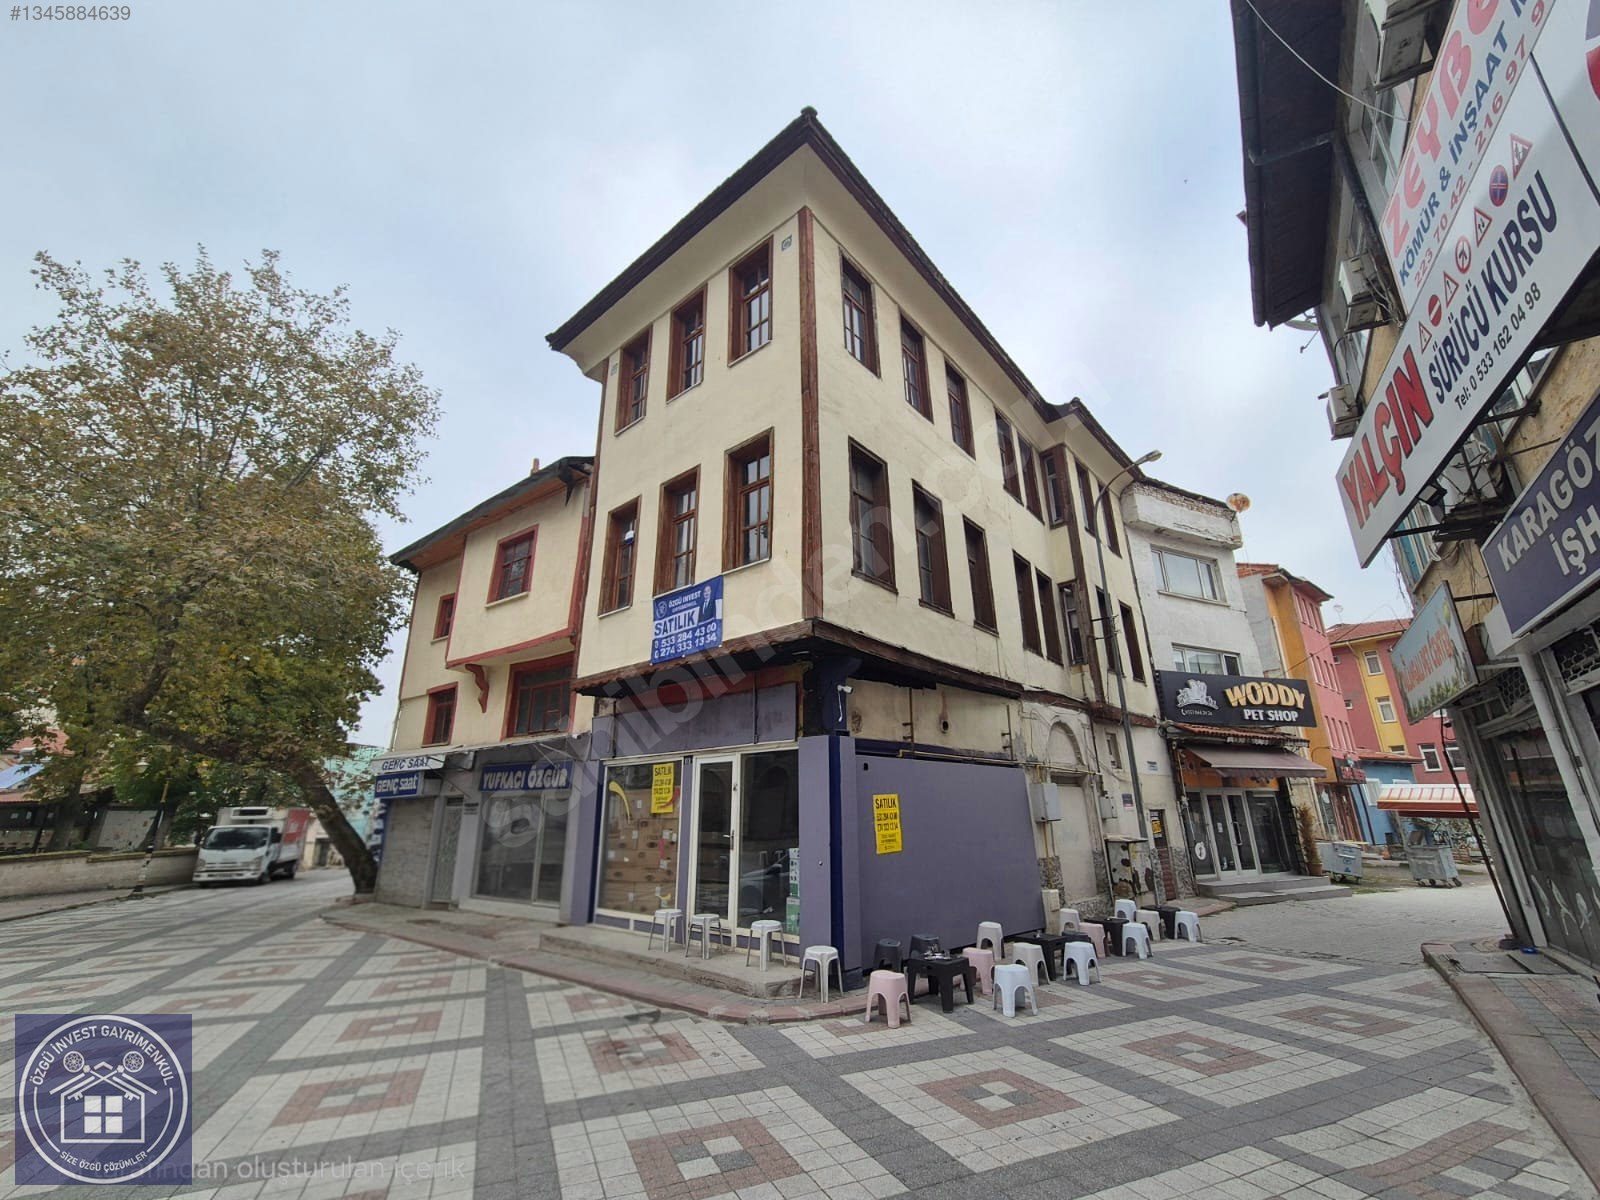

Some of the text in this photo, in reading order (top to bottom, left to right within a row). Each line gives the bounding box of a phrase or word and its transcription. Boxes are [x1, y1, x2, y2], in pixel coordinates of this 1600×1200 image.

[1399, 192, 1440, 287] KÖMÜR
[1449, 20, 1508, 165] İNŞAAT
[1414, 250, 1434, 288] 223
[1433, 213, 1448, 244] 70
[1450, 175, 1466, 210] 42
[1475, 94, 1503, 150] 216
[1429, 170, 1558, 405] SÜRÜCÜ KURSU
[1454, 387, 1472, 411] Tel:
[1476, 357, 1494, 383] 533
[1493, 326, 1513, 357] 162
[1510, 303, 1526, 331] 04
[1524, 281, 1541, 310] 98
[1342, 344, 1435, 530] YALÇIN
[654, 610, 696, 636] SATILIK
[660, 645, 675, 657] 274
[676, 640, 692, 652] 333
[694, 636, 705, 647] 13
[661, 635, 675, 647] 533
[694, 626, 706, 637] 43
[1224, 682, 1305, 709] WODDY
[1244, 709, 1299, 722] PET SHOP
[376, 779, 399, 795] GENÇ
[527, 764, 568, 788] ÖZGÜR
